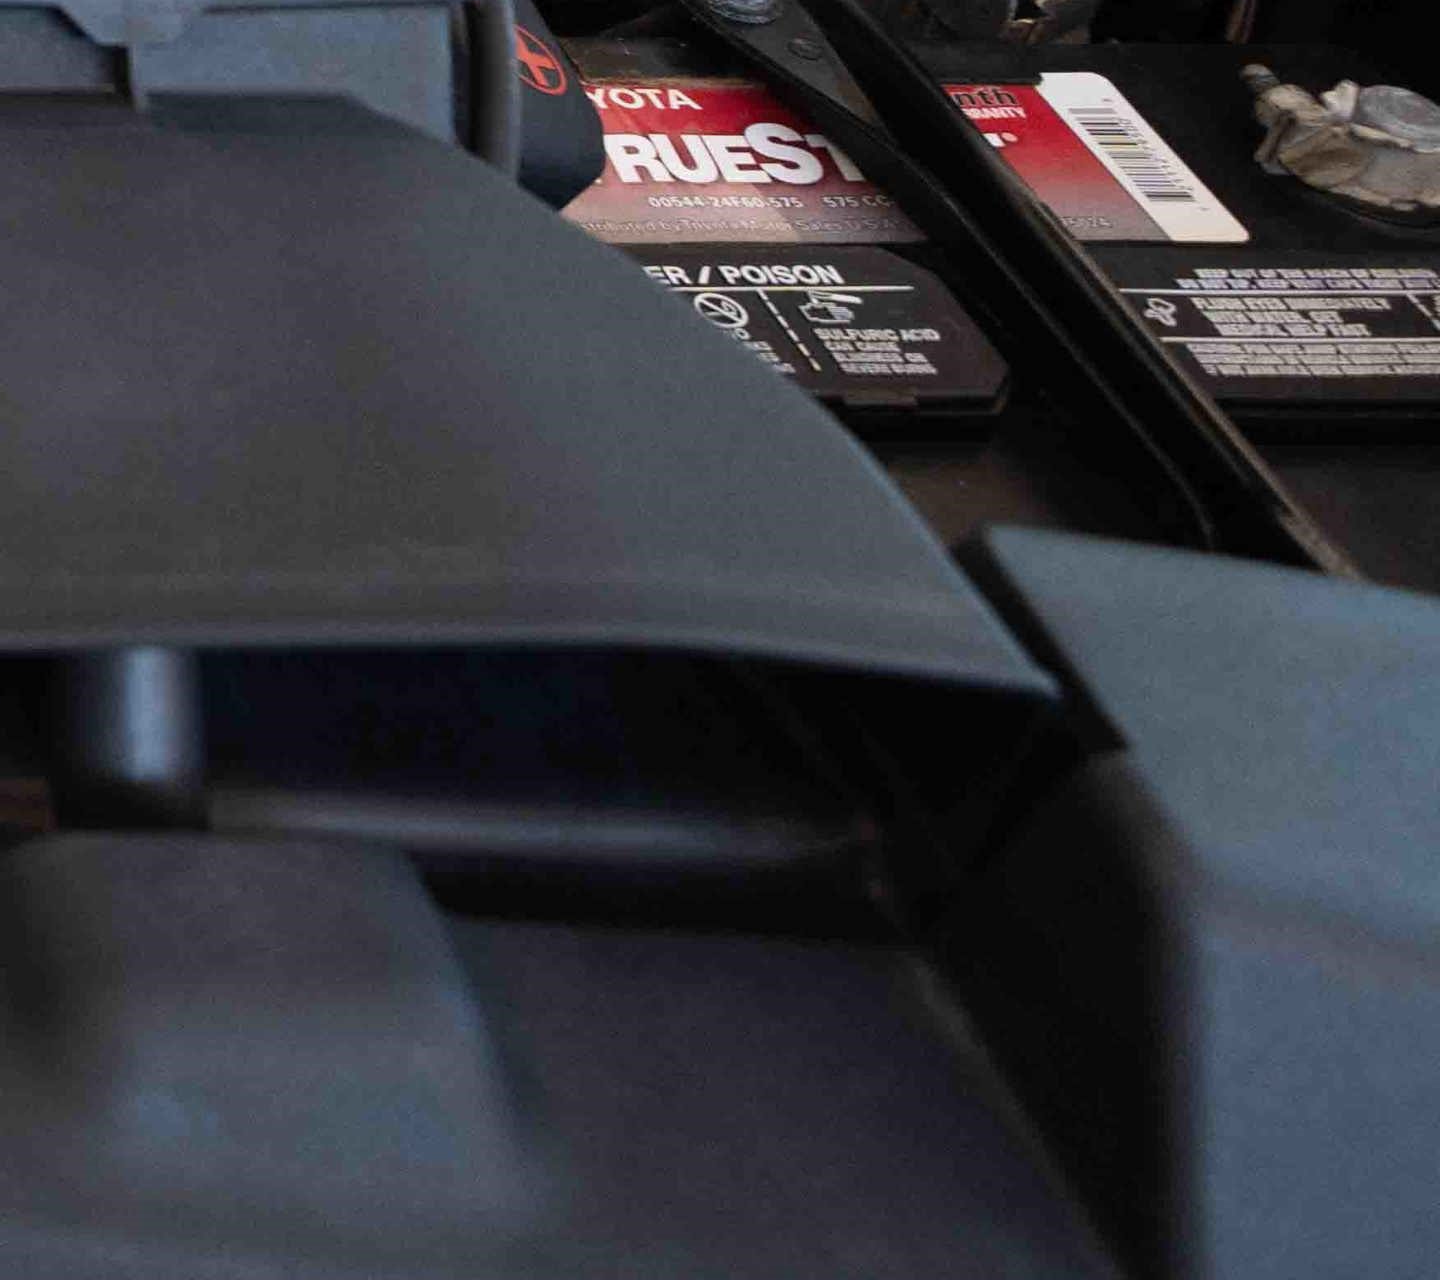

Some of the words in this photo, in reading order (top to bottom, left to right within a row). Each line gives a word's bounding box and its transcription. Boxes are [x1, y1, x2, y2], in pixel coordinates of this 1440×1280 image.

[585, 88, 703, 110] YOTA
[595, 122, 866, 184] RUEST
[822, 196, 859, 208] 575
[718, 266, 845, 285] POISON
